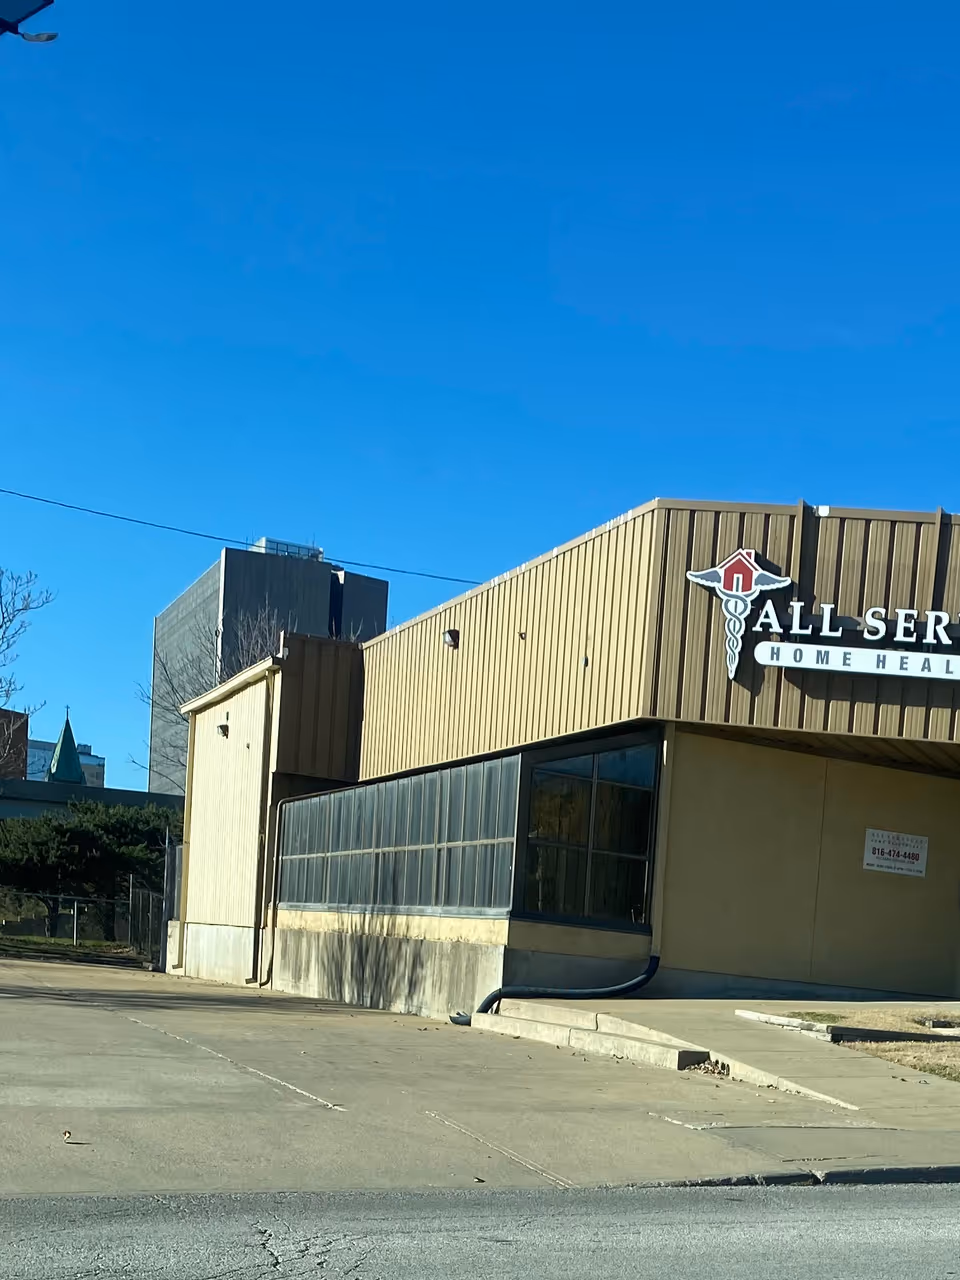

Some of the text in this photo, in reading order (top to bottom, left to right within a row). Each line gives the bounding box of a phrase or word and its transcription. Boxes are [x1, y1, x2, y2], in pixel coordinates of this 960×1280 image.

[752, 600, 844, 638] ALL
[769, 646, 852, 667] HOME
[871, 846, 920, 862] 816-474-4480
